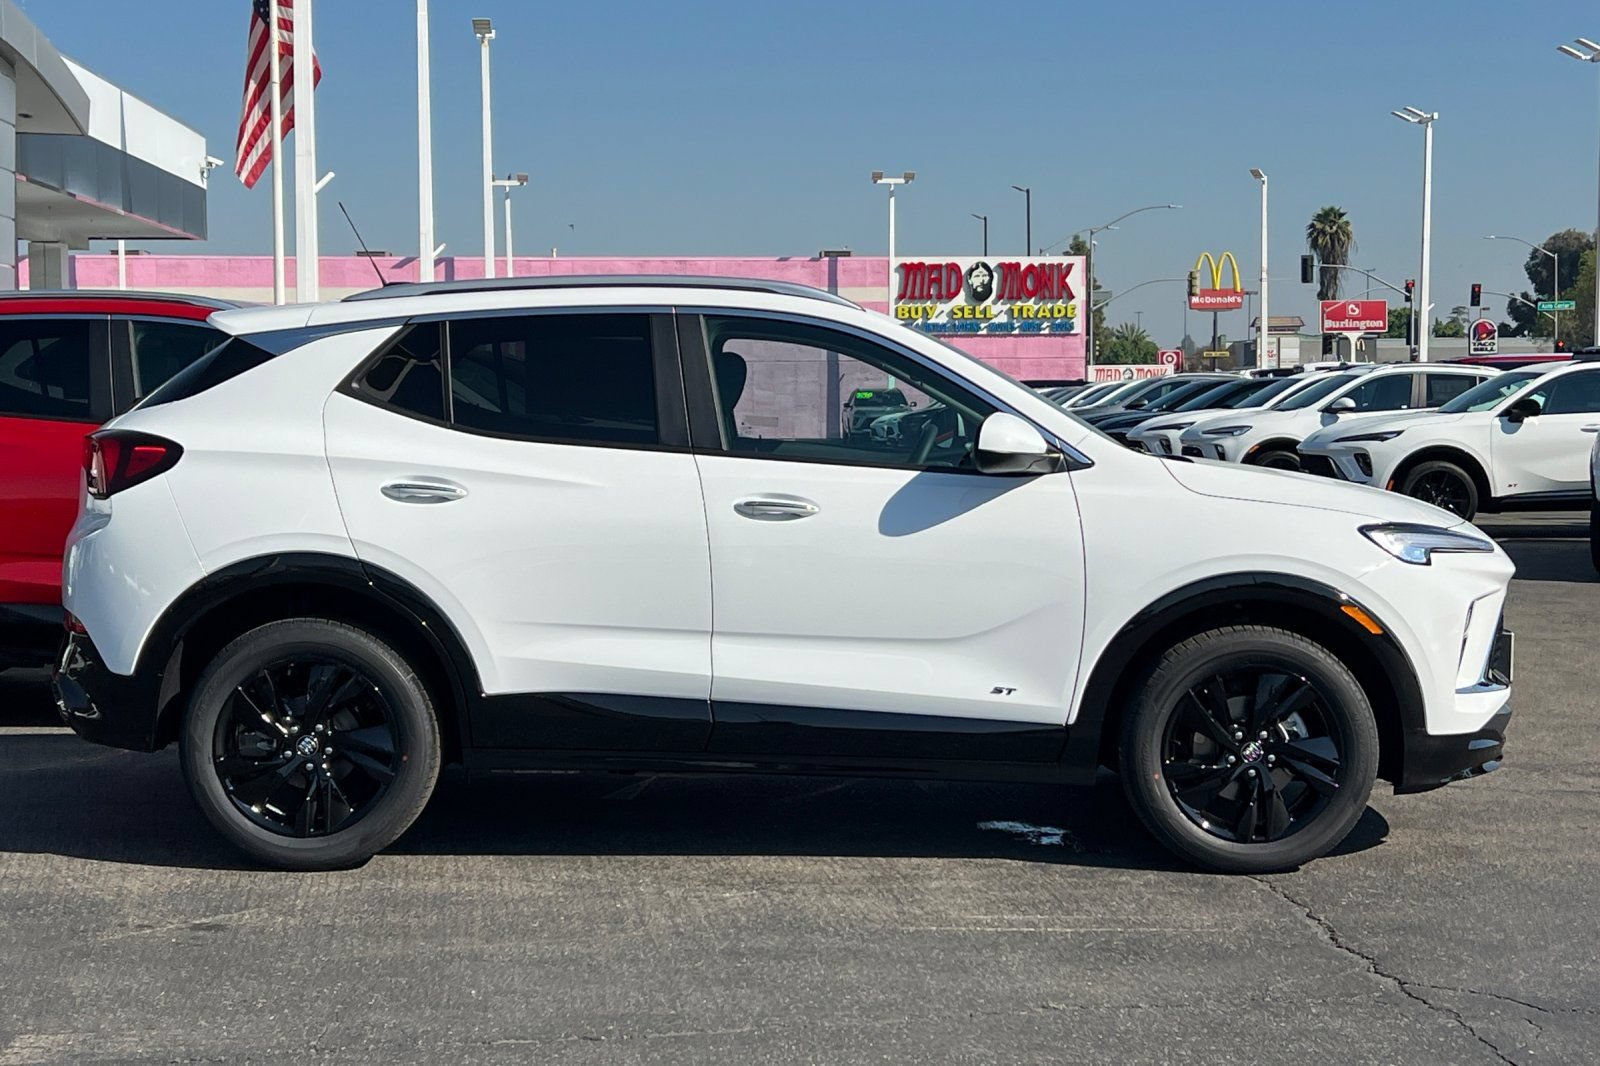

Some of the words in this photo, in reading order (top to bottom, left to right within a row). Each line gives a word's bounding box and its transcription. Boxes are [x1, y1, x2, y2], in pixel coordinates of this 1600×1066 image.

[897, 262, 963, 301] MAD
[996, 262, 1075, 301] MONK
[1191, 296, 1242, 304] McDonald's
[897, 304, 937, 319] BUY
[952, 304, 995, 319] SELL
[1011, 304, 1076, 319] TRADE
[1324, 319, 1383, 329] Burlington
[1094, 368, 1120, 381] MAD
[990, 686, 1017, 696] ST
